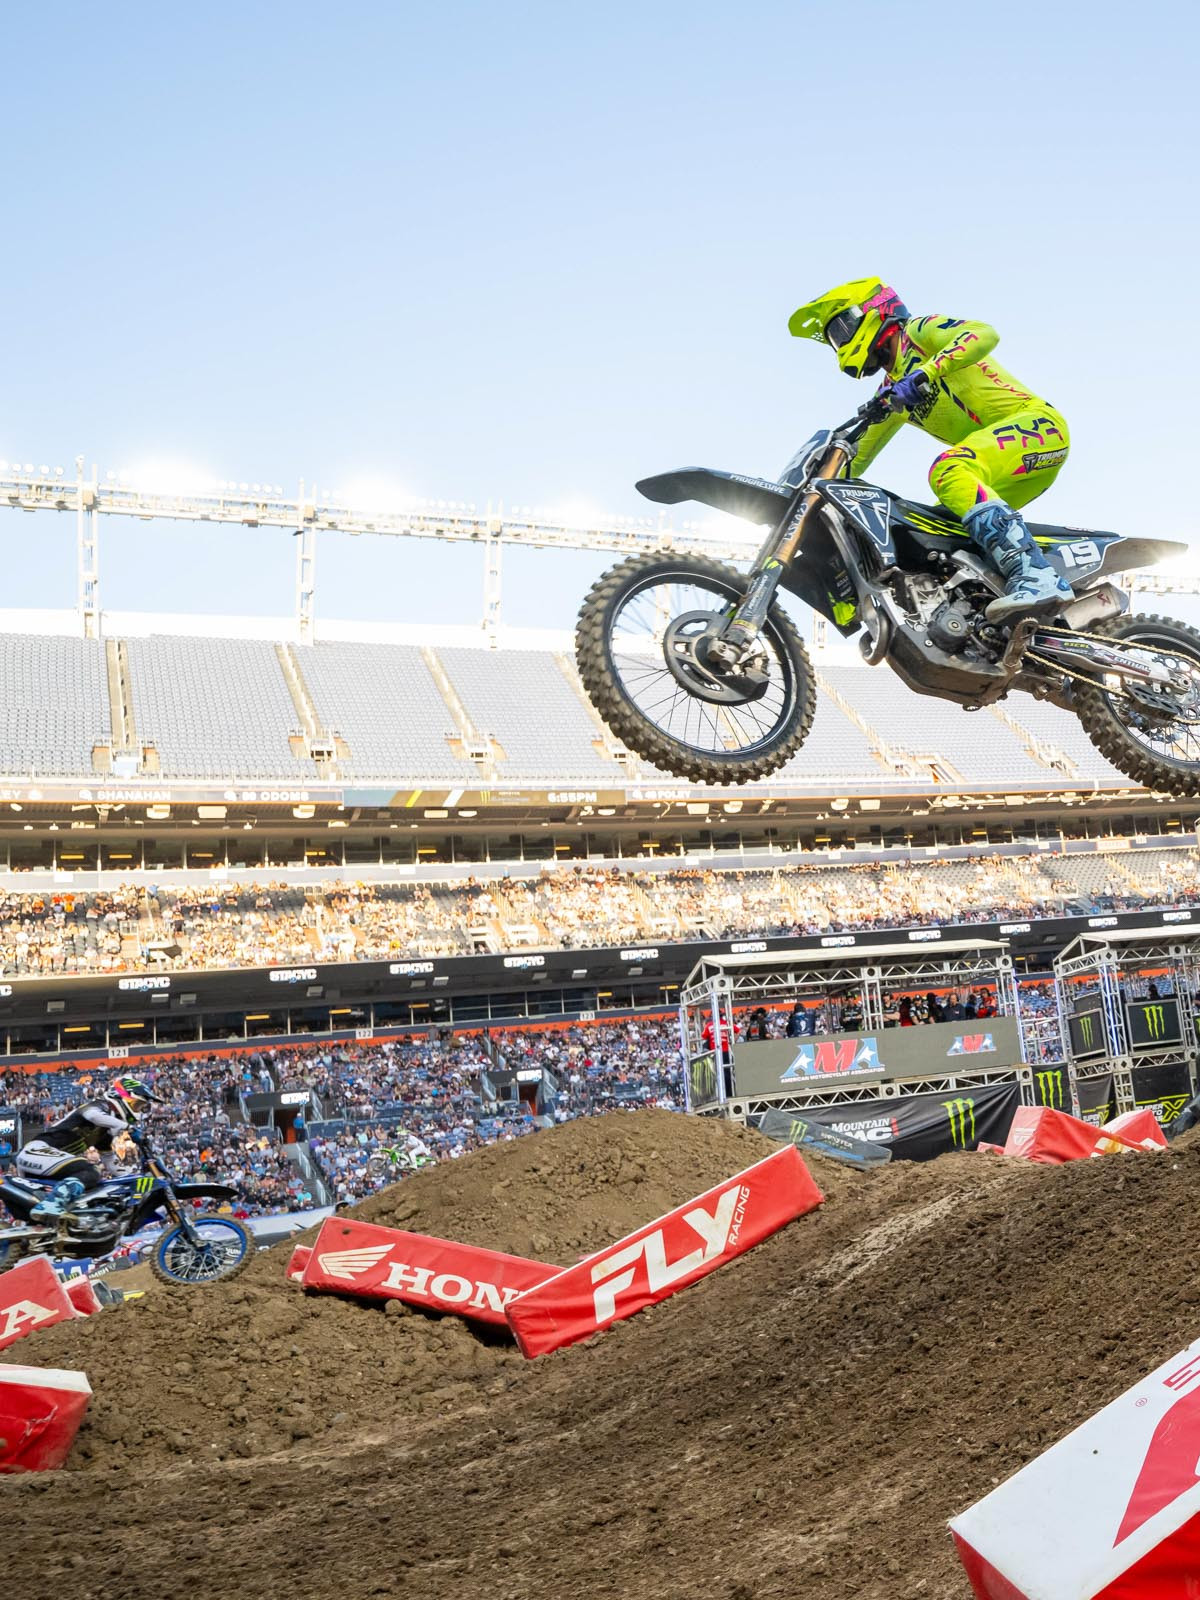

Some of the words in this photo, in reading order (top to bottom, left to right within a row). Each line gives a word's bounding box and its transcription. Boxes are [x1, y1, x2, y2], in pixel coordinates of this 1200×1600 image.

[729, 473, 786, 494] PROGRESSIVE
[840, 488, 881, 499] TRIUMPH
[1057, 541, 1101, 568] 19
[1063, 641, 1090, 649] EXCEL
[98, 790, 171, 801] SHANAHAN
[582, 1012, 594, 1020] 123
[357, 1030, 371, 1038] 122
[947, 1033, 997, 1056] AMA
[111, 1049, 127, 1057] 121
[780, 1037, 885, 1079] AMA
[781, 1075, 809, 1083] AMERICAN
[810, 1071, 850, 1081] MOTORCYCLIST
[851, 1067, 885, 1076] ASSOCIATION
[831, 1117, 890, 1134] MOUNTAIN
[19, 1159, 43, 1170] YAMAHA
[729, 1186, 751, 1247] RACING
[591, 1183, 742, 1324] FLY
[381, 1261, 518, 1317] HON
